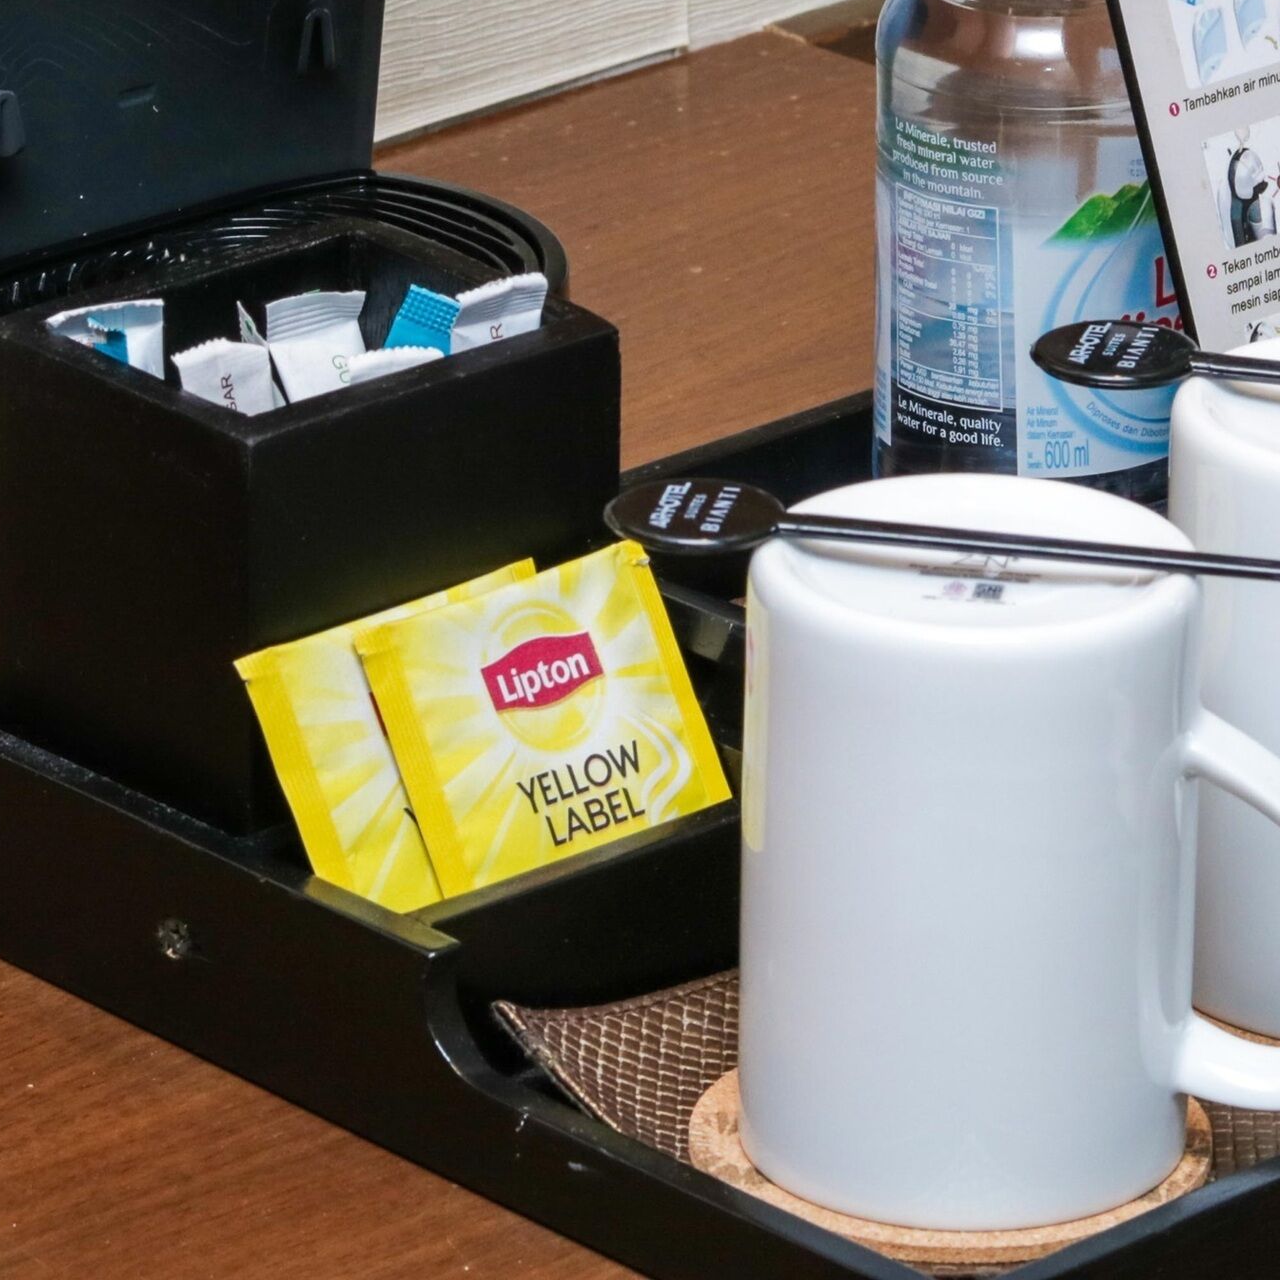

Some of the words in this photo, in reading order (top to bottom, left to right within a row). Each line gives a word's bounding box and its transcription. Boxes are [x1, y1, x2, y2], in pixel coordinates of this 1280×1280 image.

[1183, 85, 1241, 112] Tambahkan
[1243, 78, 1256, 94] air
[896, 133, 916, 153] fresh
[918, 145, 956, 164] mineral
[959, 156, 995, 169] water
[905, 121, 951, 148] Minerale,
[953, 136, 997, 154] trusted
[892, 149, 928, 174] produced
[930, 163, 959, 179] from
[961, 171, 1004, 186] source
[912, 173, 926, 188] the
[927, 180, 985, 200] mountain.
[1155, 255, 1177, 308] L
[1221, 255, 1252, 276] Tekan
[1226, 274, 1264, 296] sampai
[1231, 292, 1261, 315] mesin
[1116, 327, 1160, 368] BIANTI
[896, 412, 920, 431] water
[922, 421, 938, 436] for
[940, 428, 947, 438] a
[949, 430, 978, 444] good
[981, 432, 1005, 448] life.
[898, 394, 907, 409] Le
[909, 400, 957, 427] Minerale,
[959, 417, 1002, 434] quality
[1086, 401, 1121, 430] Diproses
[1122, 424, 1138, 435] dan
[1045, 440, 1070, 470] 600
[1074, 439, 1090, 468] ml
[699, 486, 741, 533] BIANTI
[495, 650, 591, 709] Lipton
[516, 740, 641, 815] YELLOW
[545, 787, 646, 848] LABEL
